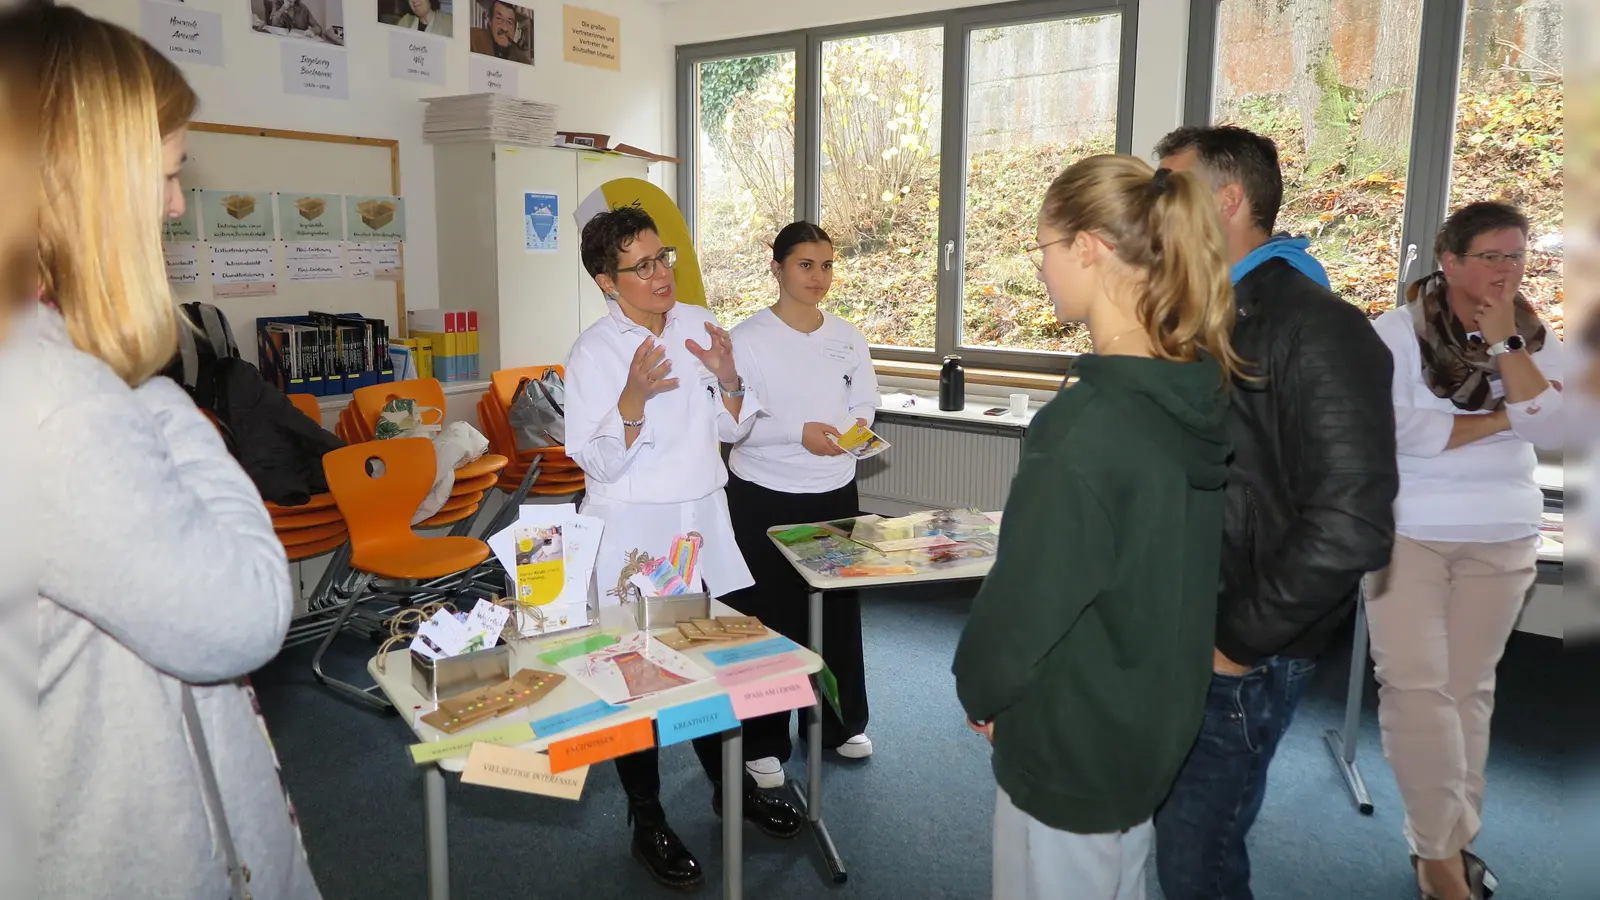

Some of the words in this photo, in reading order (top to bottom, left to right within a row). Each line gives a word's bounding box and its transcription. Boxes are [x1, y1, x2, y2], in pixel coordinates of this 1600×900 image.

[581, 20, 590, 28] Die
[482, 762, 530, 779] VIELSEITIGE
[531, 772, 579, 787] INTERESSEN
